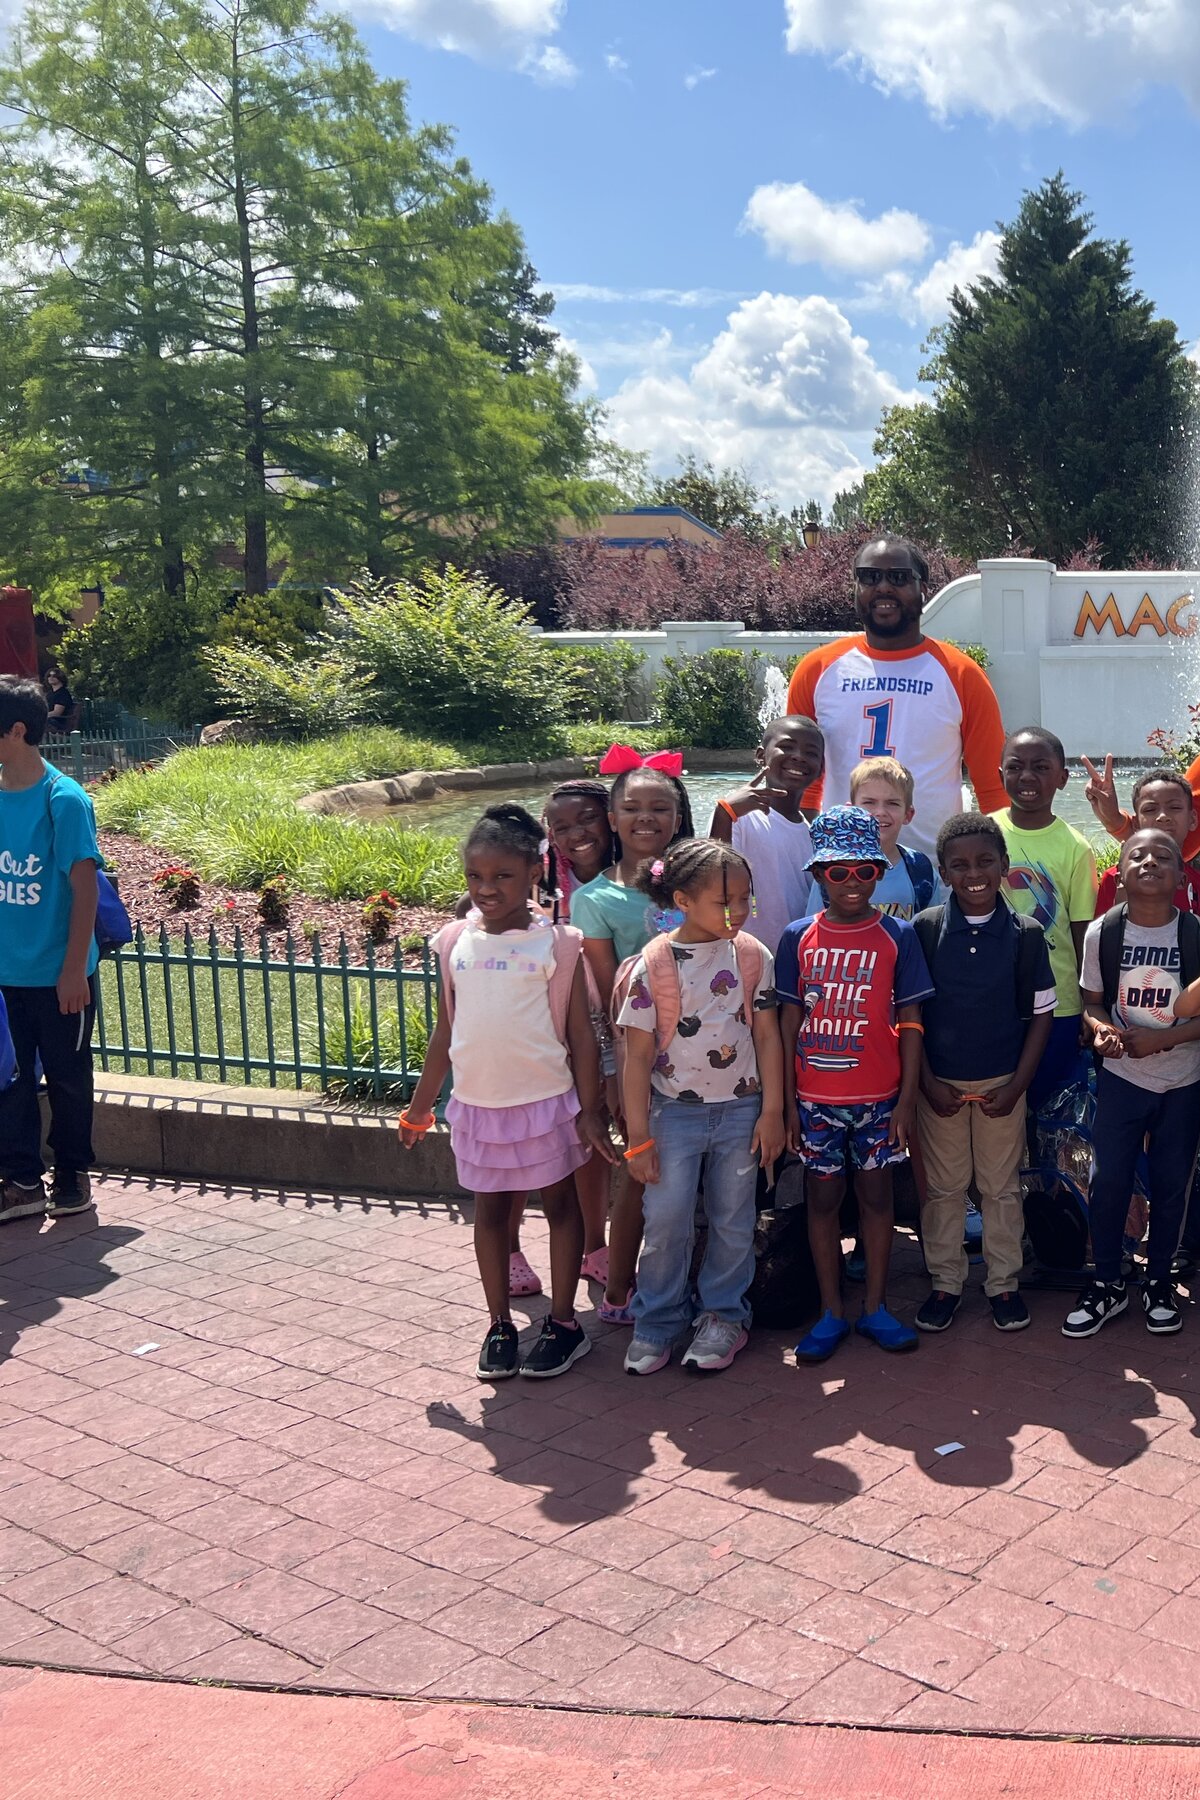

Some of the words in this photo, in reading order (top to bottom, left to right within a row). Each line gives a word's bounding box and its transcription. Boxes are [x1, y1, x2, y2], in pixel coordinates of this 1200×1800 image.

[1074, 590, 1199, 638] MAG
[841, 677, 934, 696] FRIENDSHIP
[860, 698, 896, 758] 1
[0, 850, 43, 877] Out
[455, 957, 537, 972] kndnss
[801, 947, 878, 983] CATCH
[1121, 945, 1180, 967] GAME
[822, 982, 872, 1018] THE
[1126, 987, 1172, 1008] DAY
[800, 1017, 869, 1052] WAVE
